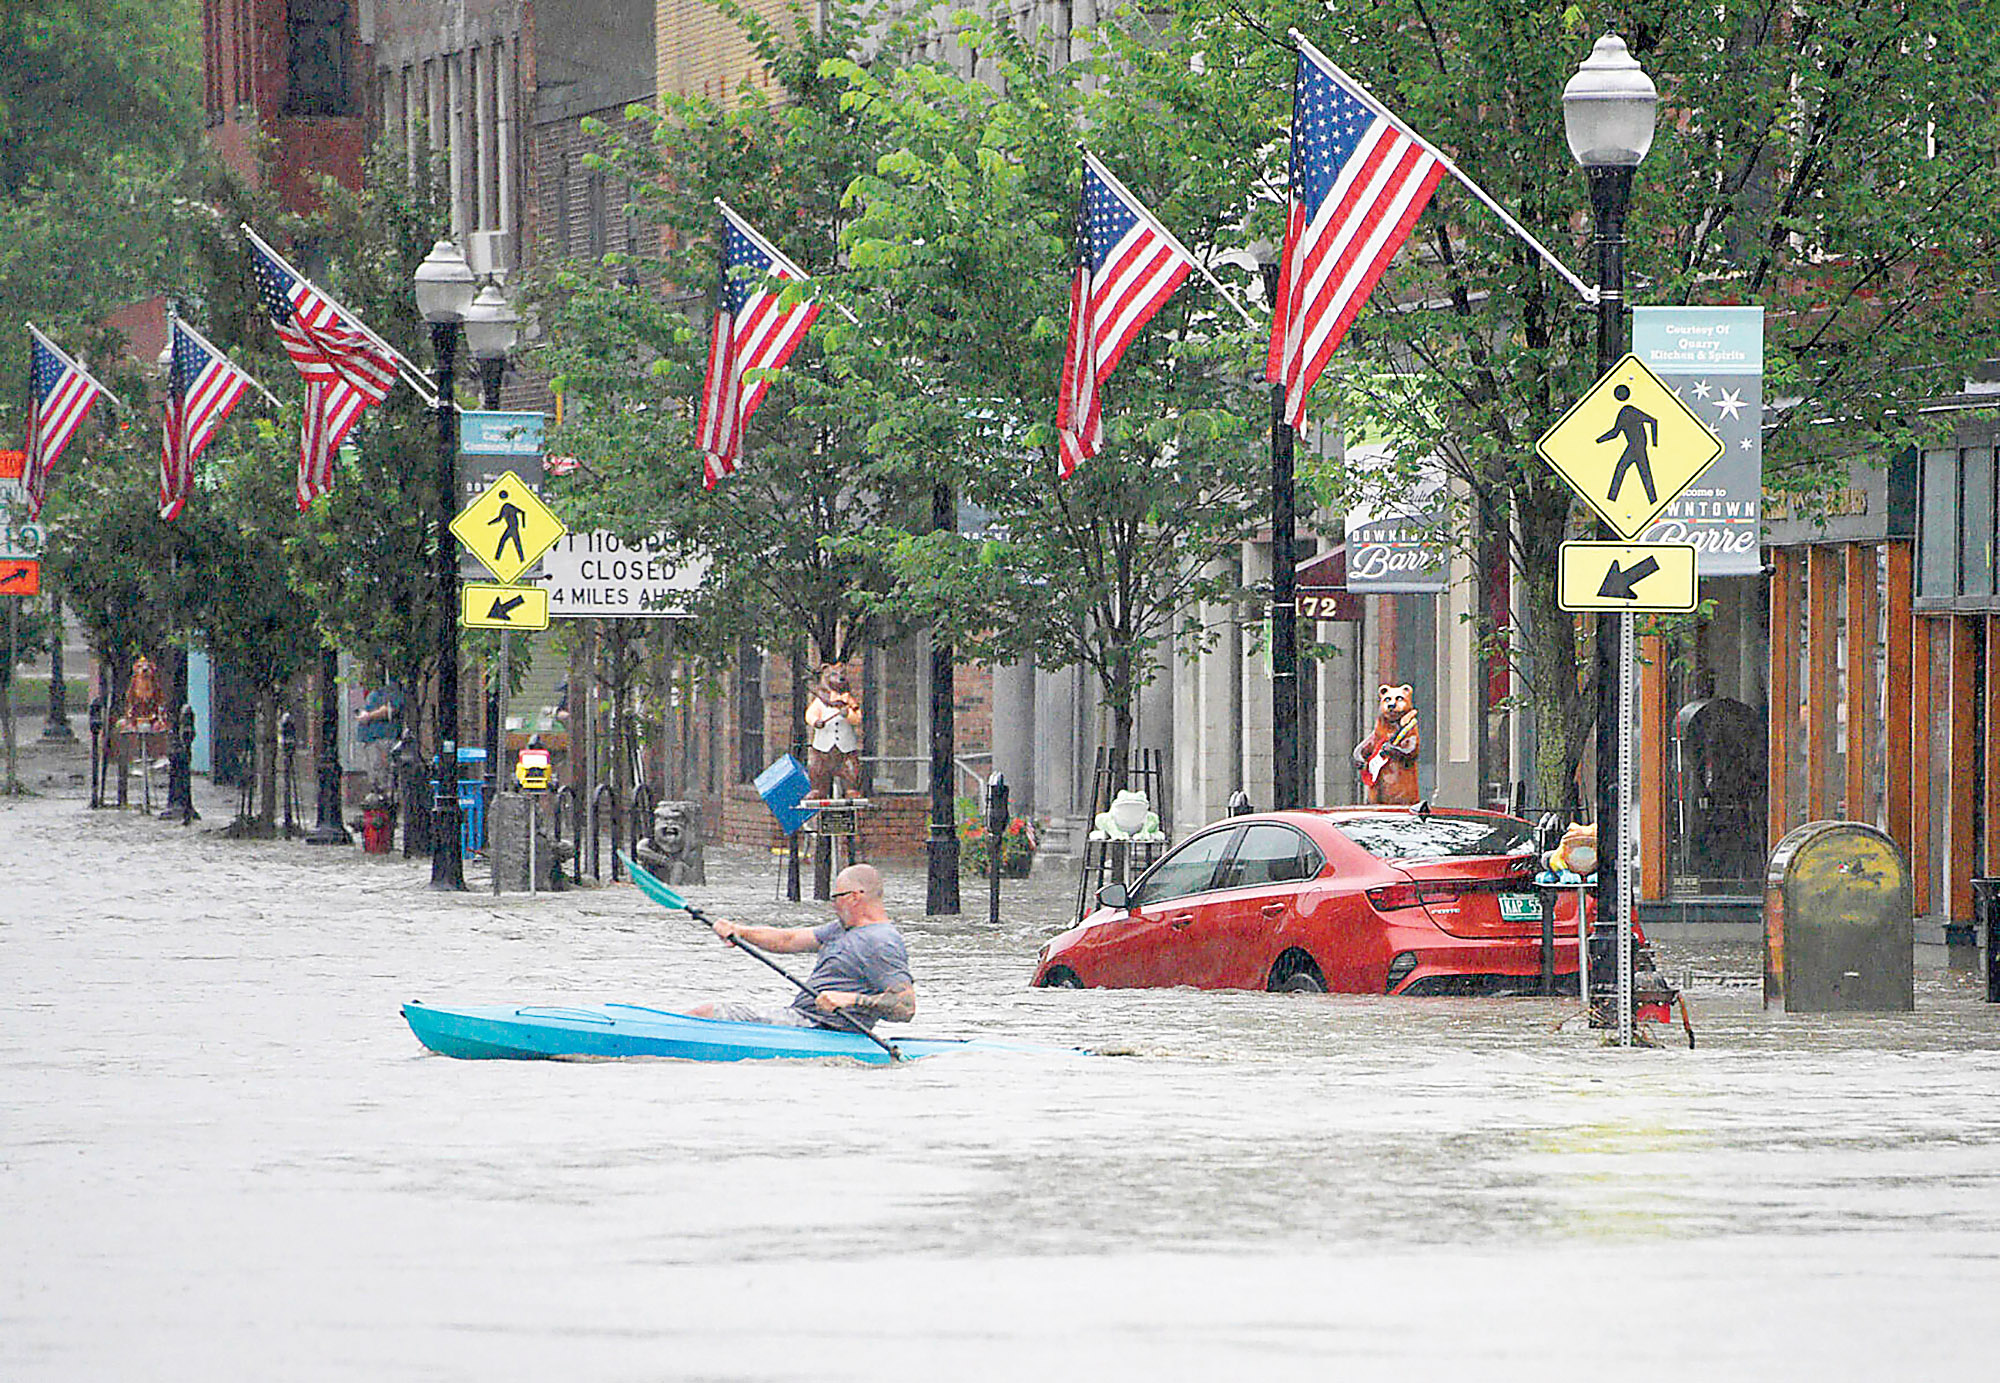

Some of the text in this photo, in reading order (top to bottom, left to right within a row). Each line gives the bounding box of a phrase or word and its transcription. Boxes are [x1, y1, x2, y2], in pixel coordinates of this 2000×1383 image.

[1666, 325, 1730, 335] Courtesy Of
[1679, 338, 1720, 349] Quarry
[1651, 350, 1745, 361] Kitchen & Spirits
[1682, 488, 1726, 497] come to
[1667, 502, 1754, 516] WNTOWN
[581, 560, 676, 580] CLOSED
[552, 588, 564, 604] 4
[571, 588, 629, 605] MILES
[1302, 597, 1337, 617] 72
[1528, 899, 1543, 913] 55
